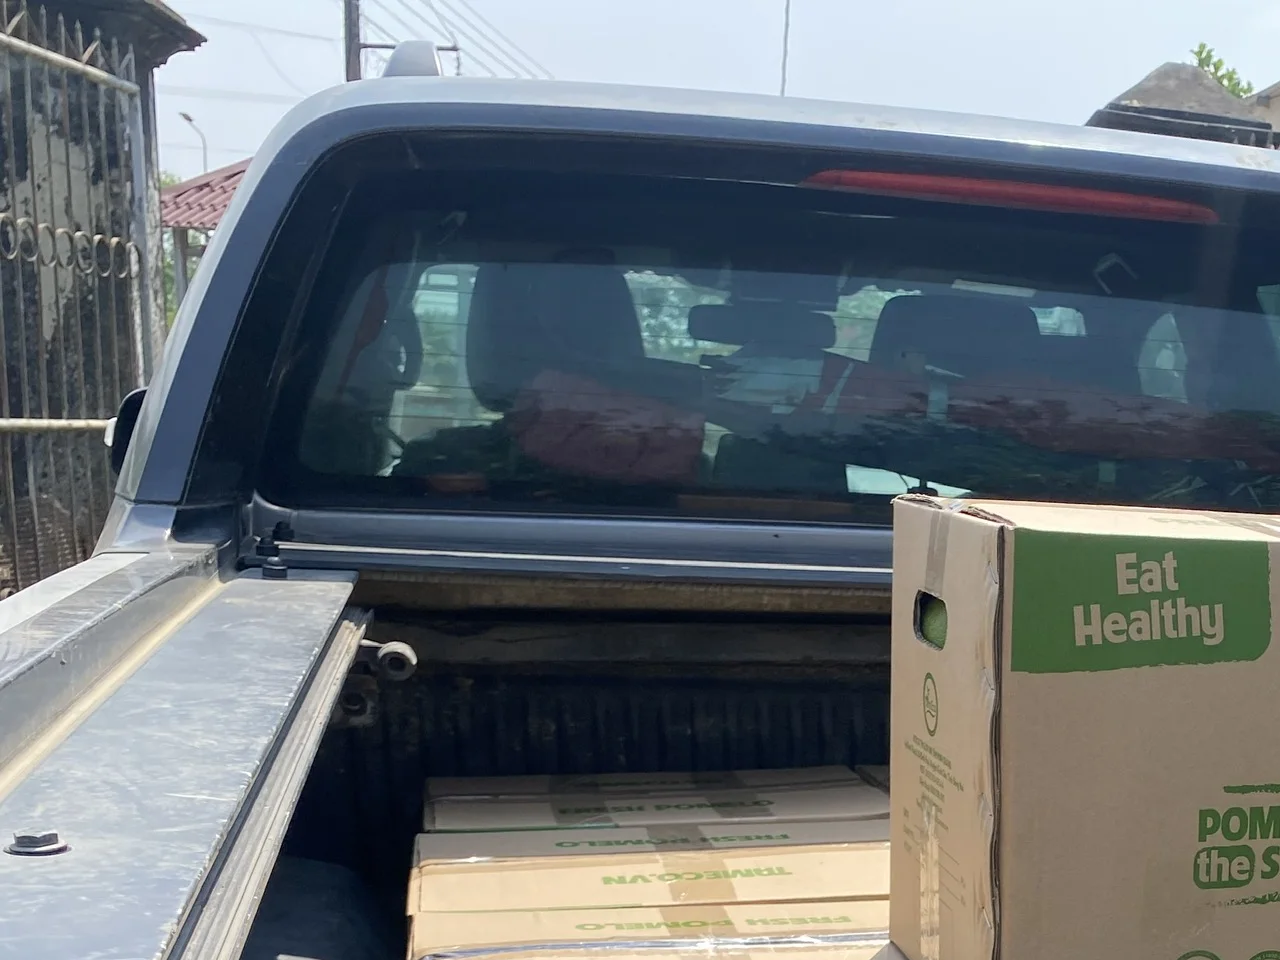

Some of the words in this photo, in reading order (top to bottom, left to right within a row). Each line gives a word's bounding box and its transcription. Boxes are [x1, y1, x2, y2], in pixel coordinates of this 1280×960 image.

[1115, 551, 1180, 595] Eat
[1073, 597, 1225, 647] Healthy
[601, 866, 793, 886] TAMECO.VN
[1196, 849, 1250, 883] the
[575, 919, 733, 931] POMELO
[745, 915, 852, 926] FRESH
